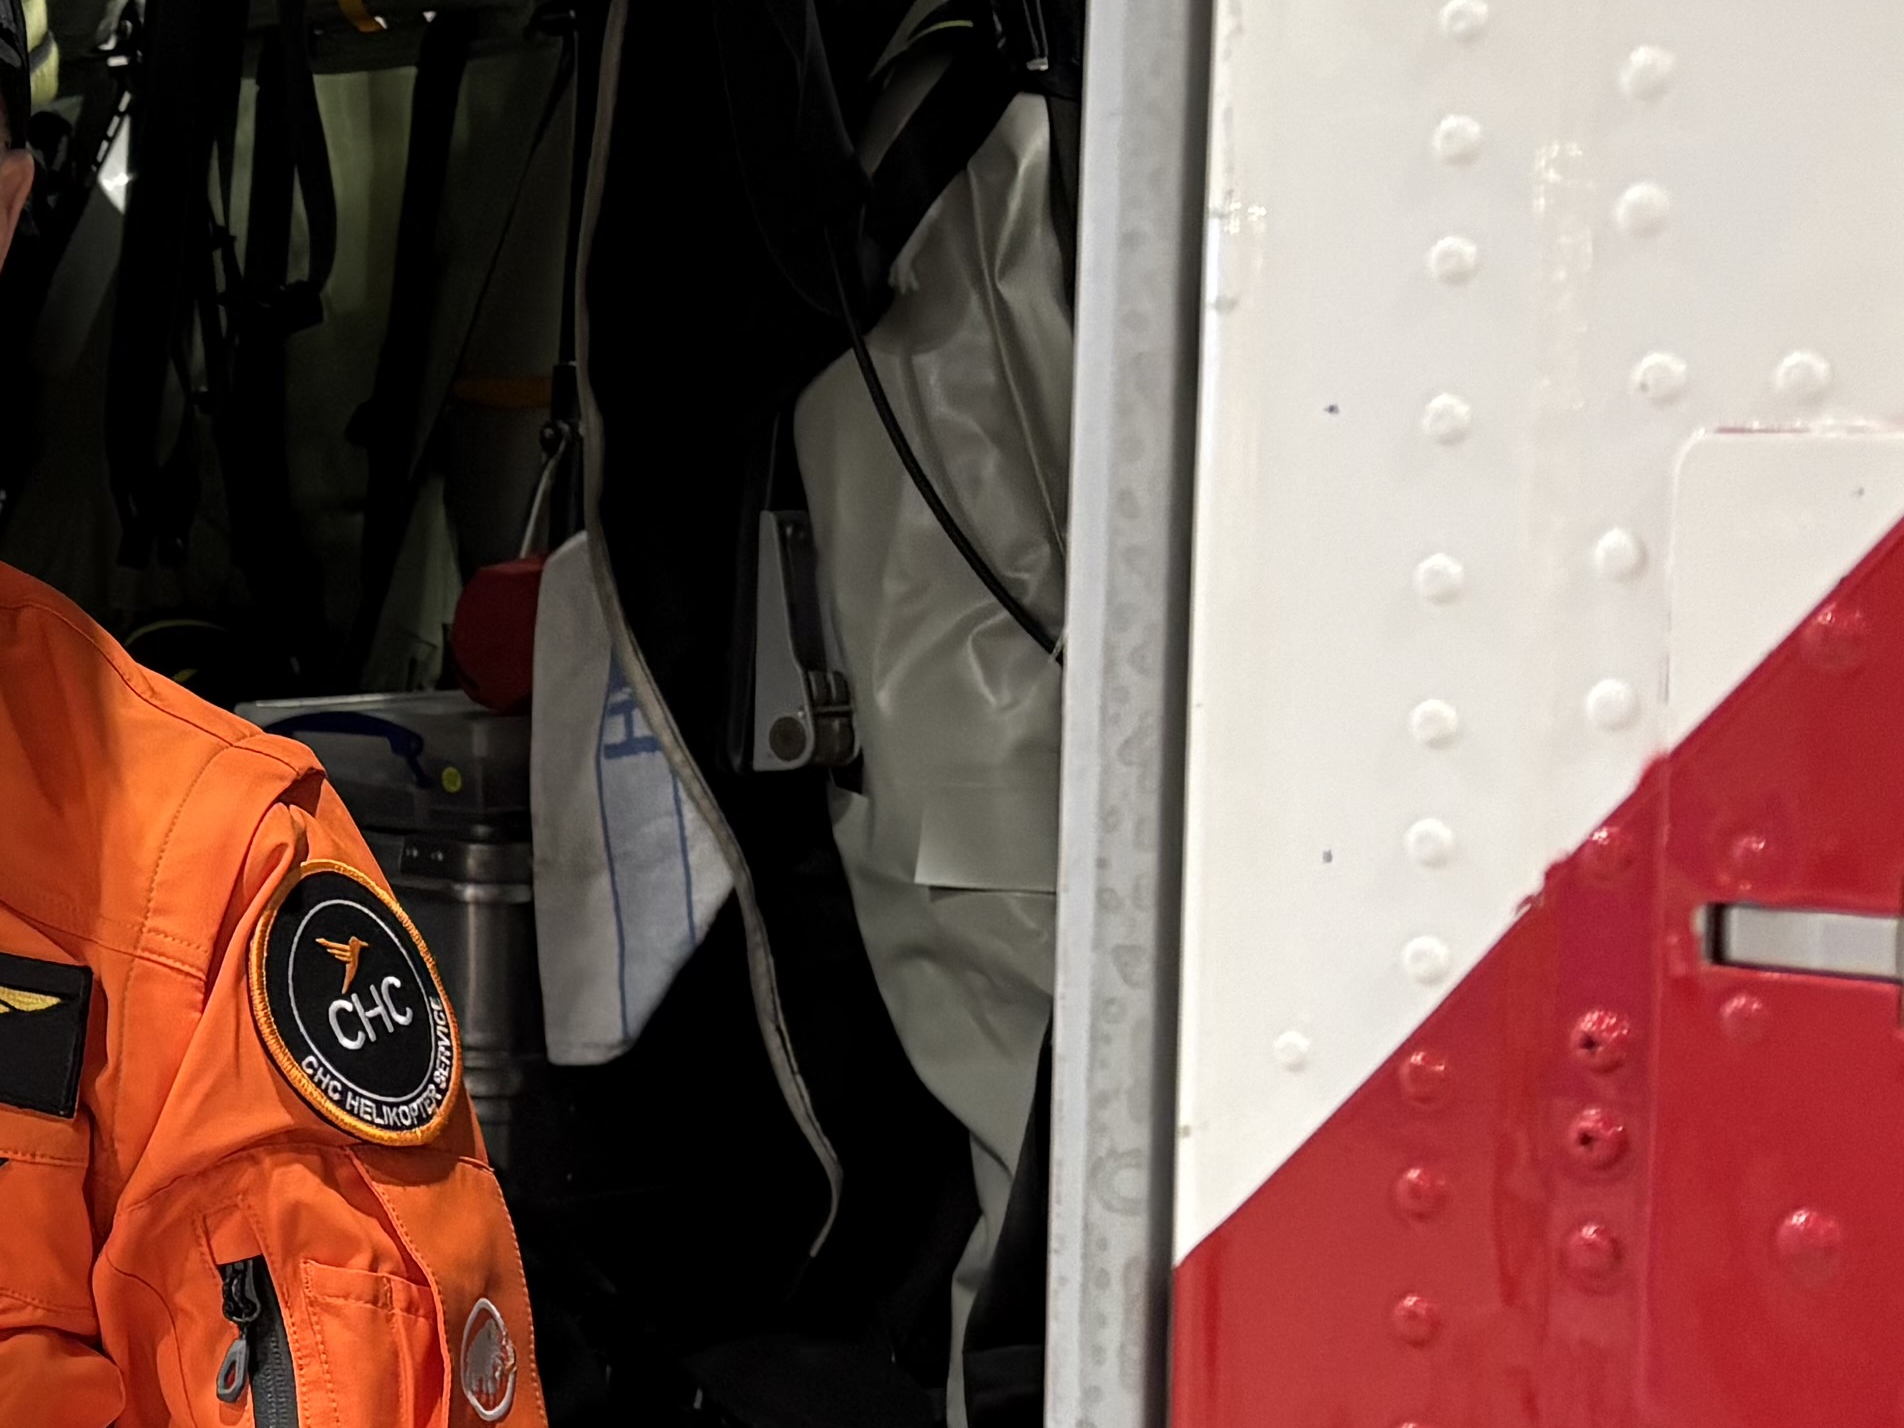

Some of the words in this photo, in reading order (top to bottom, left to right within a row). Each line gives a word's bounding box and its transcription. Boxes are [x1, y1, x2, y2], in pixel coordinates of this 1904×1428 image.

[301, 1055, 343, 1101] CHC
[345, 1083, 442, 1127] HELIKOPTER
[429, 995, 452, 1090] SERVICE
[328, 975, 413, 1050] CHC
